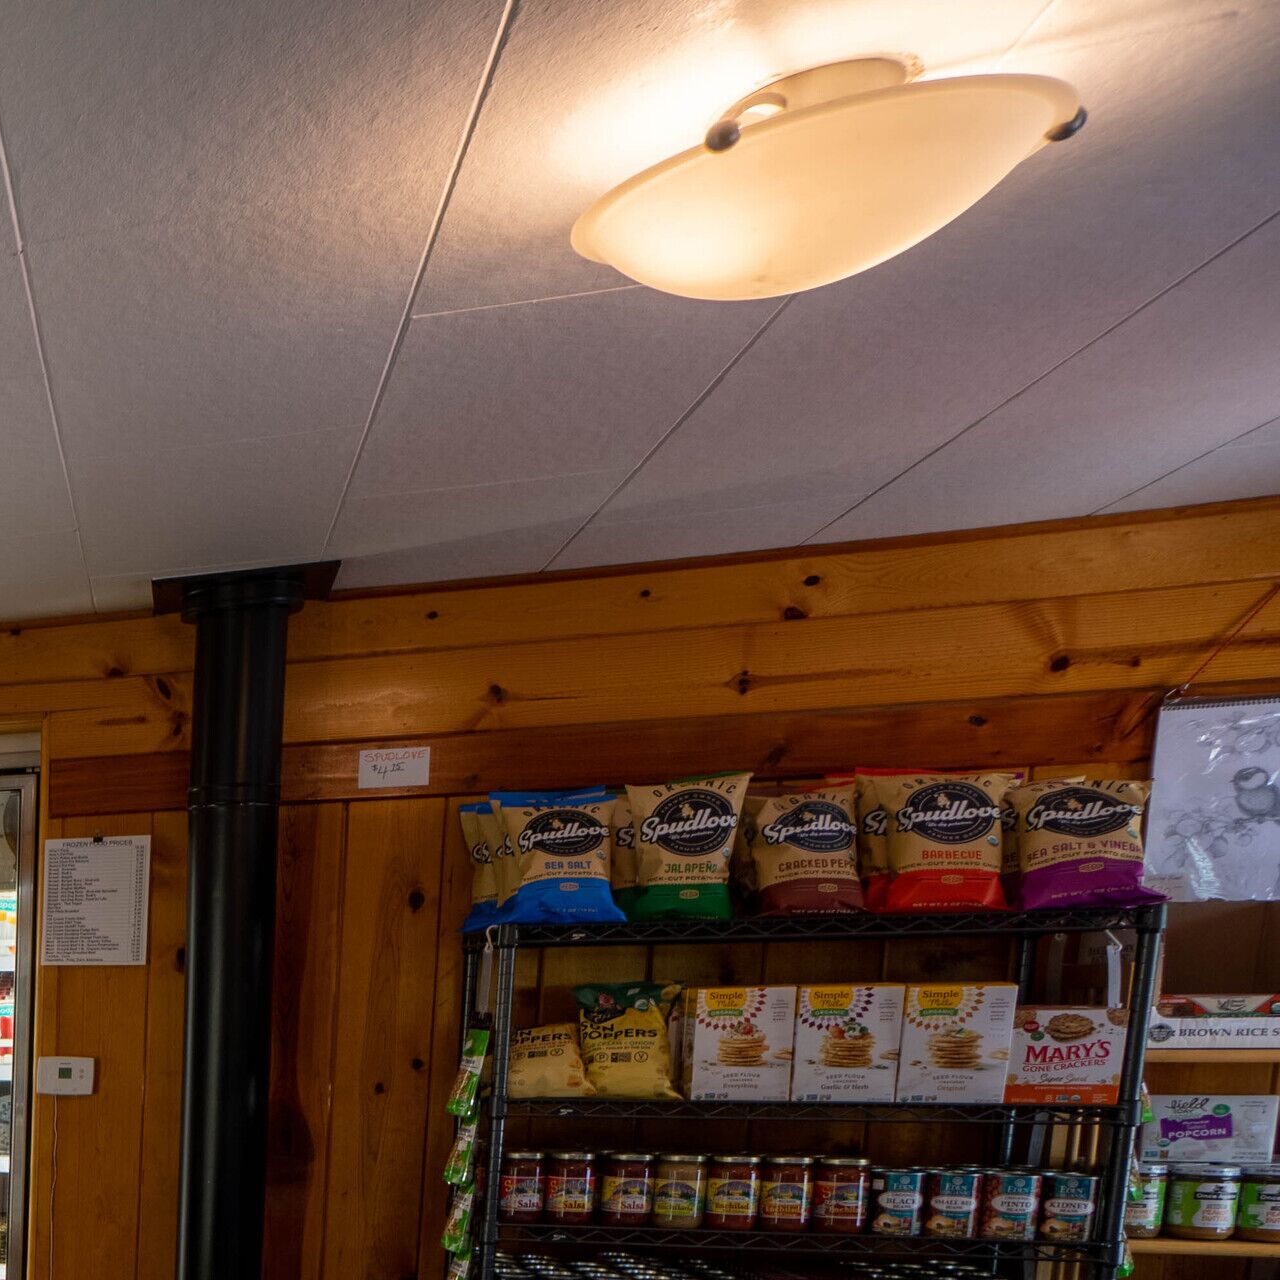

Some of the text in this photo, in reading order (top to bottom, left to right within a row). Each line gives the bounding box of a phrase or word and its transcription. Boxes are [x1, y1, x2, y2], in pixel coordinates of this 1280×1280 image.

[364, 749, 426, 763] SPUDLOVE
[896, 800, 1002, 833] Spudlove
[1027, 801, 1143, 833] Spudlove
[640, 808, 738, 843] Spudlove
[763, 812, 857, 844] Spudlove
[518, 824, 610, 851] Spudlove
[921, 849, 982, 860] BARBECUE
[1027, 847, 1049, 862] SEA
[1052, 842, 1084, 855] SALT
[544, 860, 592, 870] SEA SALT
[778, 859, 827, 872] CRACKED
[709, 991, 743, 1001] Simple
[813, 991, 849, 1001] Simple
[922, 989, 960, 1000] Simple
[581, 1028, 657, 1042] POPPERS
[1178, 1027, 1269, 1037] BROWN RICE
[1025, 1040, 1111, 1063] MARY'S
[1022, 1058, 1106, 1073] GONE CRACKERS
[1168, 1127, 1227, 1139] POPCORN
[999, 1200, 1032, 1208] PINTO
[1048, 1201, 1089, 1209] KIDNEY
